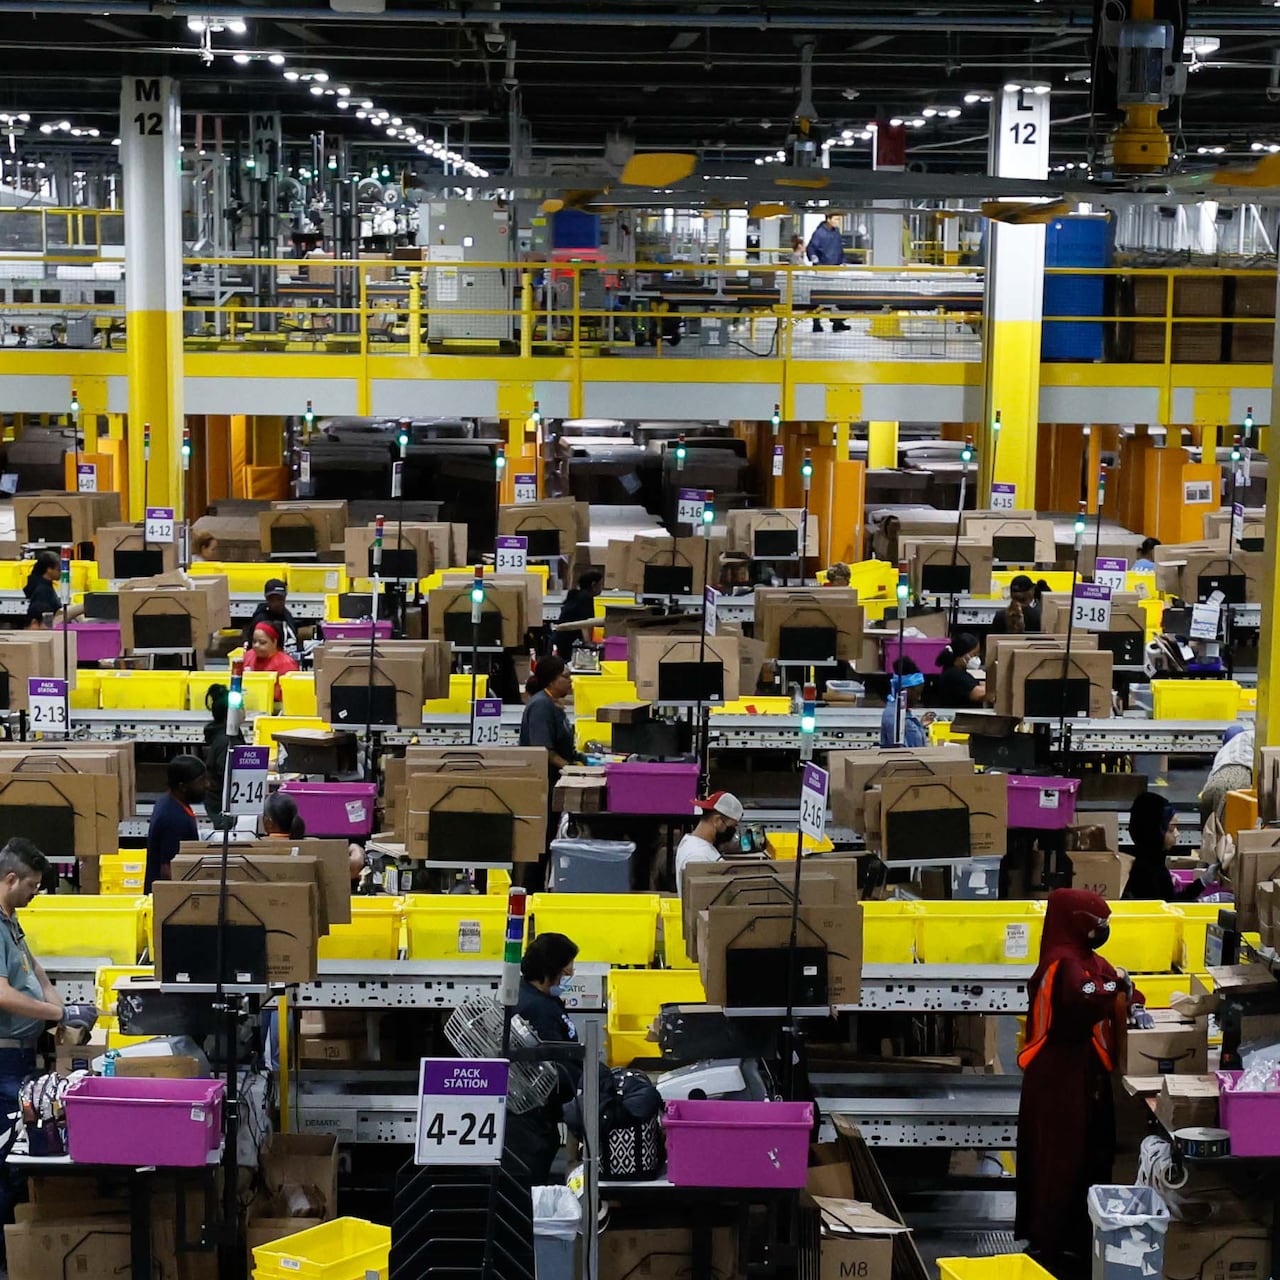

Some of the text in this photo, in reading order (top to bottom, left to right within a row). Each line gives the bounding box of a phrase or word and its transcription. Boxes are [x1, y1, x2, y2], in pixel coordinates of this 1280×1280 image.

[134, 78, 160, 102] M
[1017, 90, 1034, 110] L
[133, 112, 164, 136] 12
[256, 115, 274, 131] M
[1009, 123, 1037, 144] 12
[679, 506, 703, 519] 4-16
[148, 525, 172, 537] 4-12
[497, 554, 524, 568] 3-13
[1075, 605, 1107, 623] 3-18
[32, 704, 66, 724] 2-13
[476, 726, 500, 744] 2-15
[238, 757, 261, 766] STATION
[242, 751, 258, 759] PACK
[230, 781, 264, 804] 2-14
[802, 798, 823, 829] 2-16
[452, 1067, 481, 1080] PACK
[443, 1077, 489, 1089] STATION
[304, 1119, 341, 1127] DEMATIC
[425, 1112, 498, 1146] 4-24
[839, 1261, 868, 1279] M8
